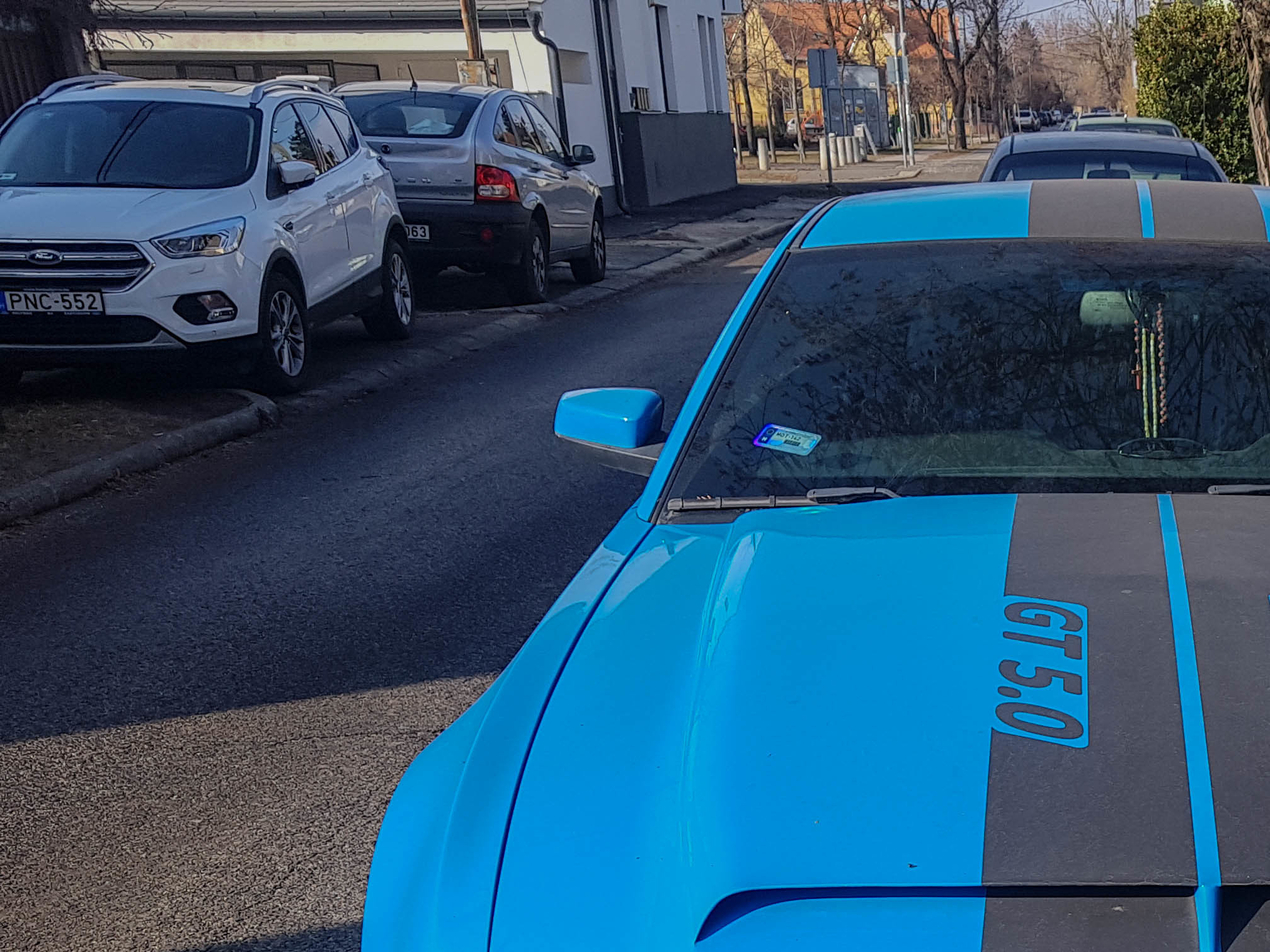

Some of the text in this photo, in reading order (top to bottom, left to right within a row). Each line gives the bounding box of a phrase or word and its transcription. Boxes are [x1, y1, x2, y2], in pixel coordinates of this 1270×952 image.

[9, 293, 98, 310] PNC-552
[995, 601, 1084, 740] GT 5.0
